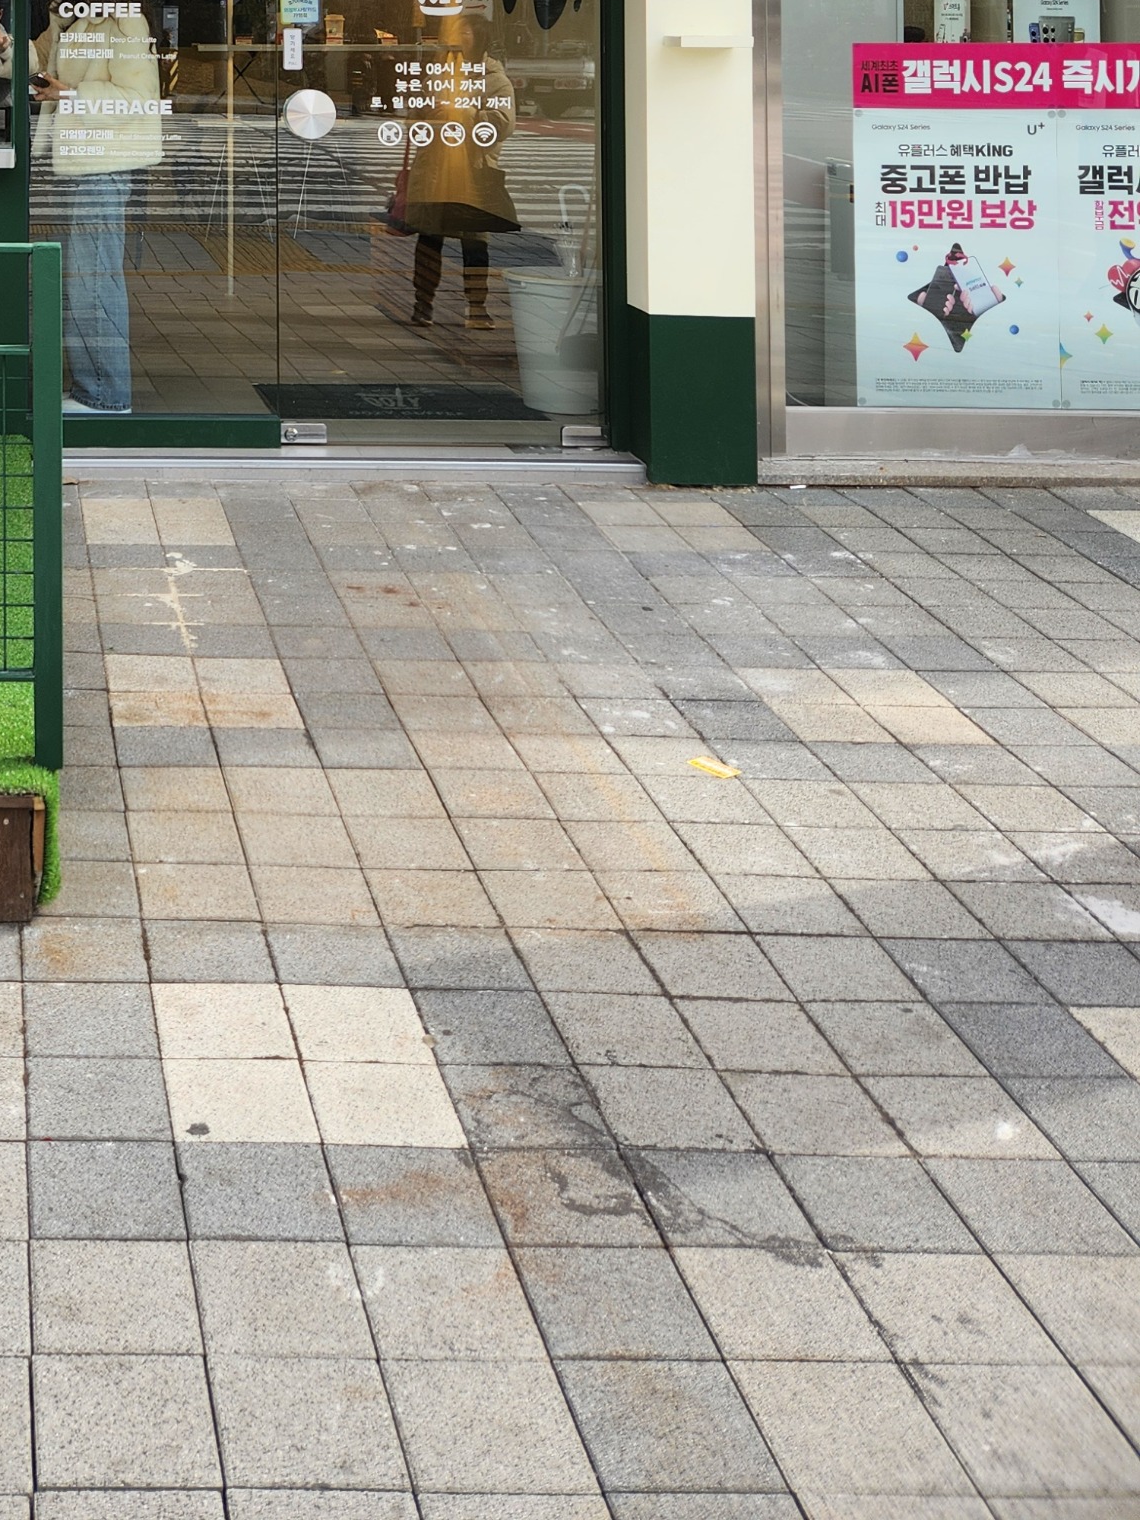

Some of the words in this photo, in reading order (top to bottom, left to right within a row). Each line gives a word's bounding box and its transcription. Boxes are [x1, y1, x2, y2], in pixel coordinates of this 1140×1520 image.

[59, 2, 142, 18] COFFEE
[395, 62, 422, 76] 이른
[426, 62, 455, 76] 08시
[460, 62, 486, 76] 부터
[861, 60, 899, 71] 세계최초
[902, 59, 1053, 94] 갤럭시S24
[395, 79, 422, 92] 늦은
[427, 79, 455, 92] 10시
[460, 79, 486, 92] 까지
[59, 99, 173, 115] BEVERAGE
[392, 97, 404, 109] 일
[408, 97, 435, 109] 08시
[454, 97, 482, 109] 22시
[486, 97, 511, 109] 까지
[872, 123, 895, 131] Galaxy
[1076, 124, 1100, 132] Galaxy
[898, 144, 948, 157] 유플러스
[880, 164, 966, 195] 중고폰
[974, 164, 1032, 195] 반납
[1077, 165, 1140, 195] 갤럭
[889, 200, 973, 229] 15만원
[979, 200, 1037, 230] 보상
[1108, 200, 1140, 230] 전
